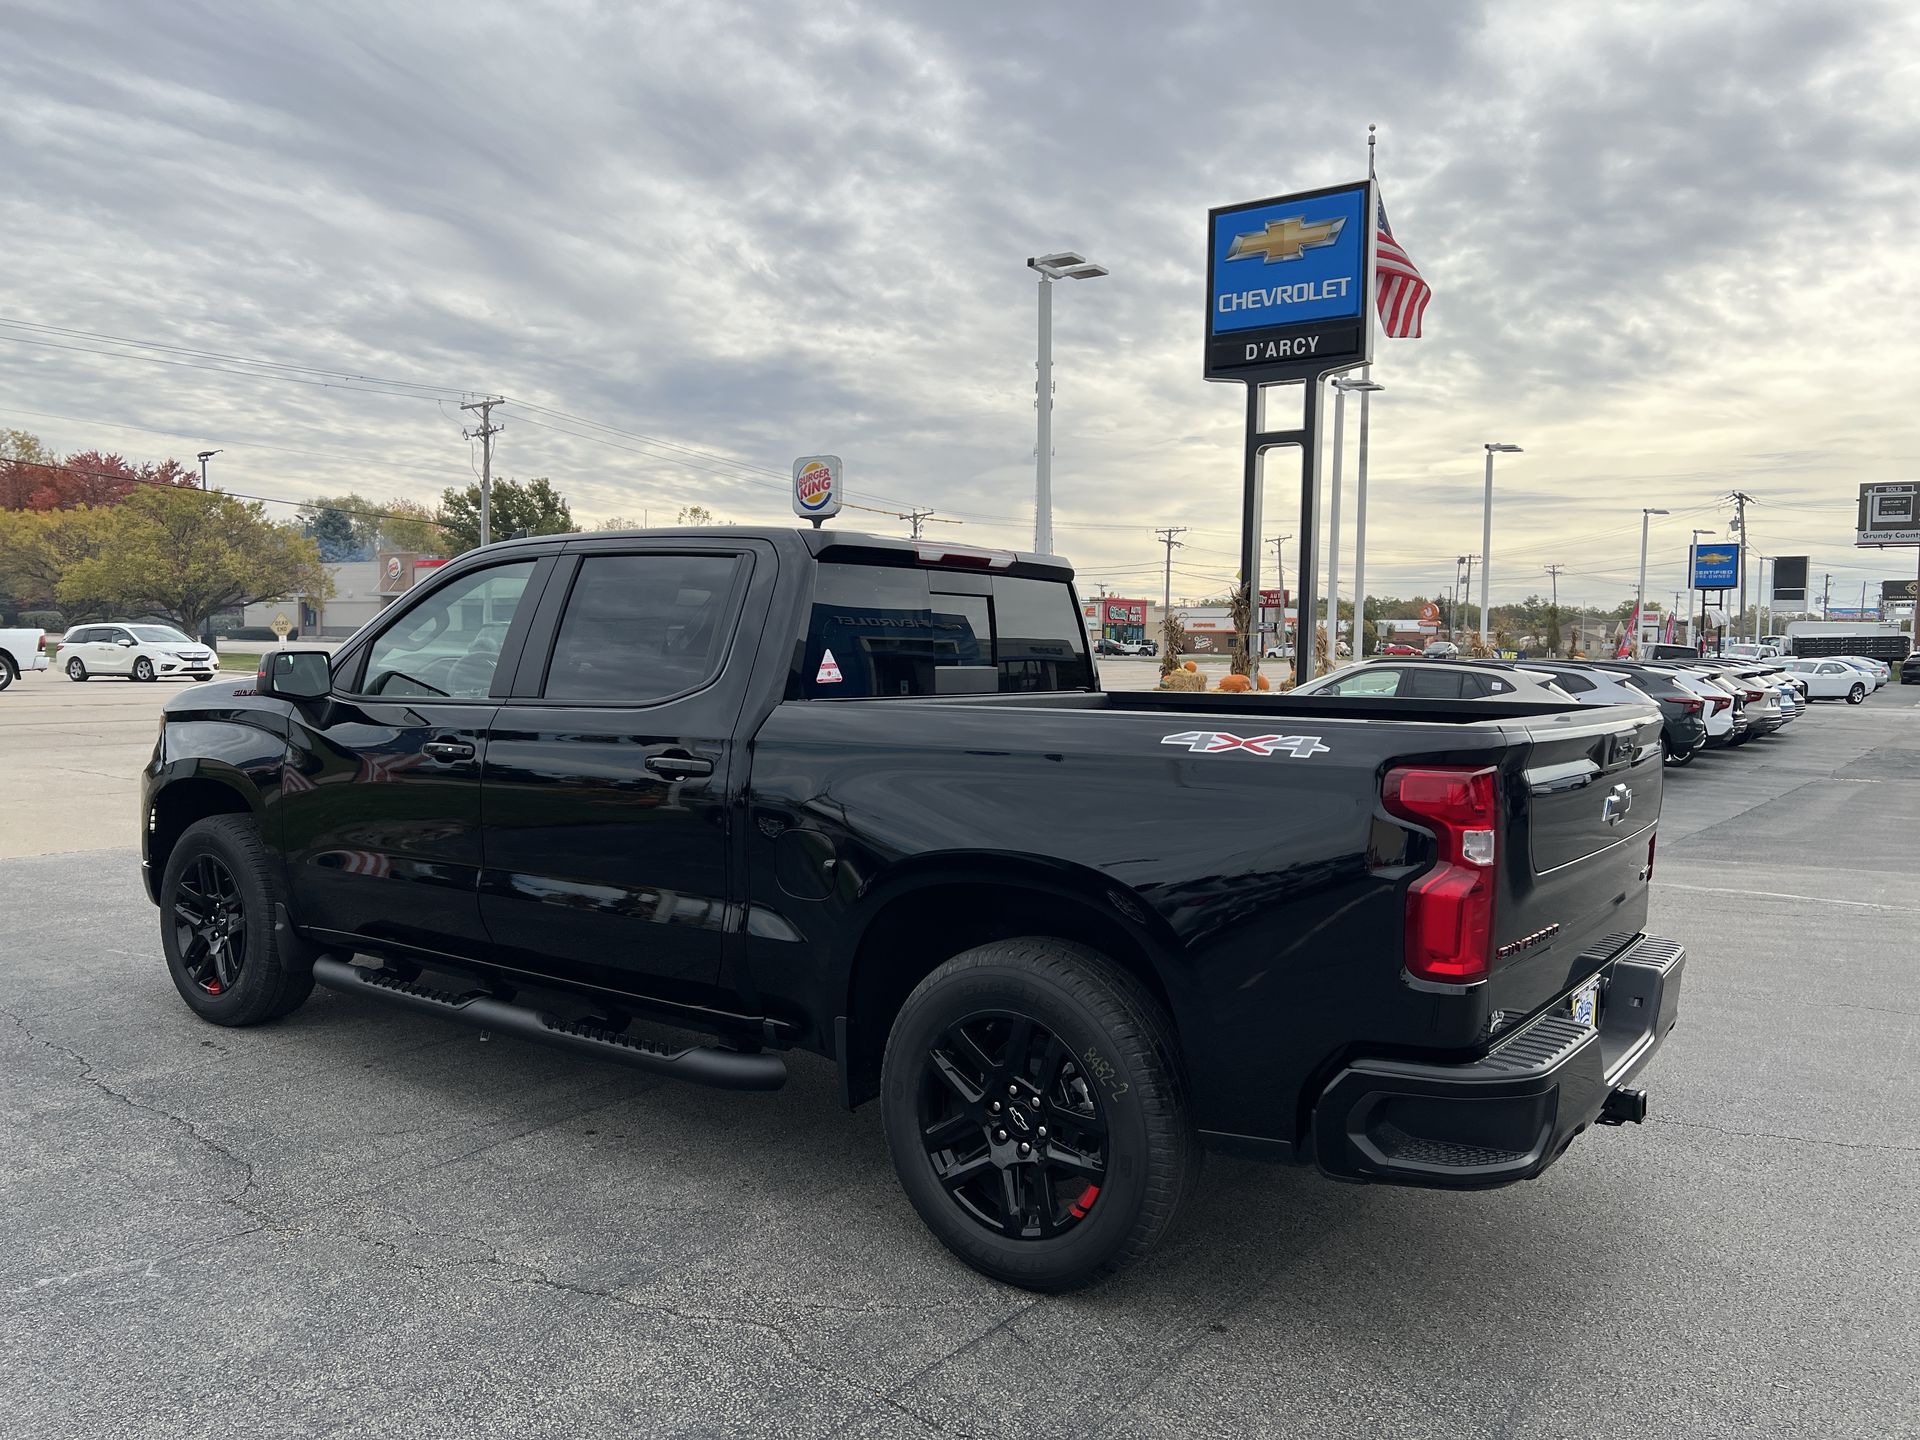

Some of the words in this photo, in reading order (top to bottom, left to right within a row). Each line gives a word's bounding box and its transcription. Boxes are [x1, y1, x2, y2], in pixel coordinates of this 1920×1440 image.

[1218, 277, 1351, 313] CHEVROLET
[1245, 336, 1320, 361] D'ARCY
[799, 467, 830, 488] BURGER
[800, 476, 831, 500] KING
[1862, 532, 1892, 540] Grundy
[1084, 1046, 1129, 1103] 8482-2
